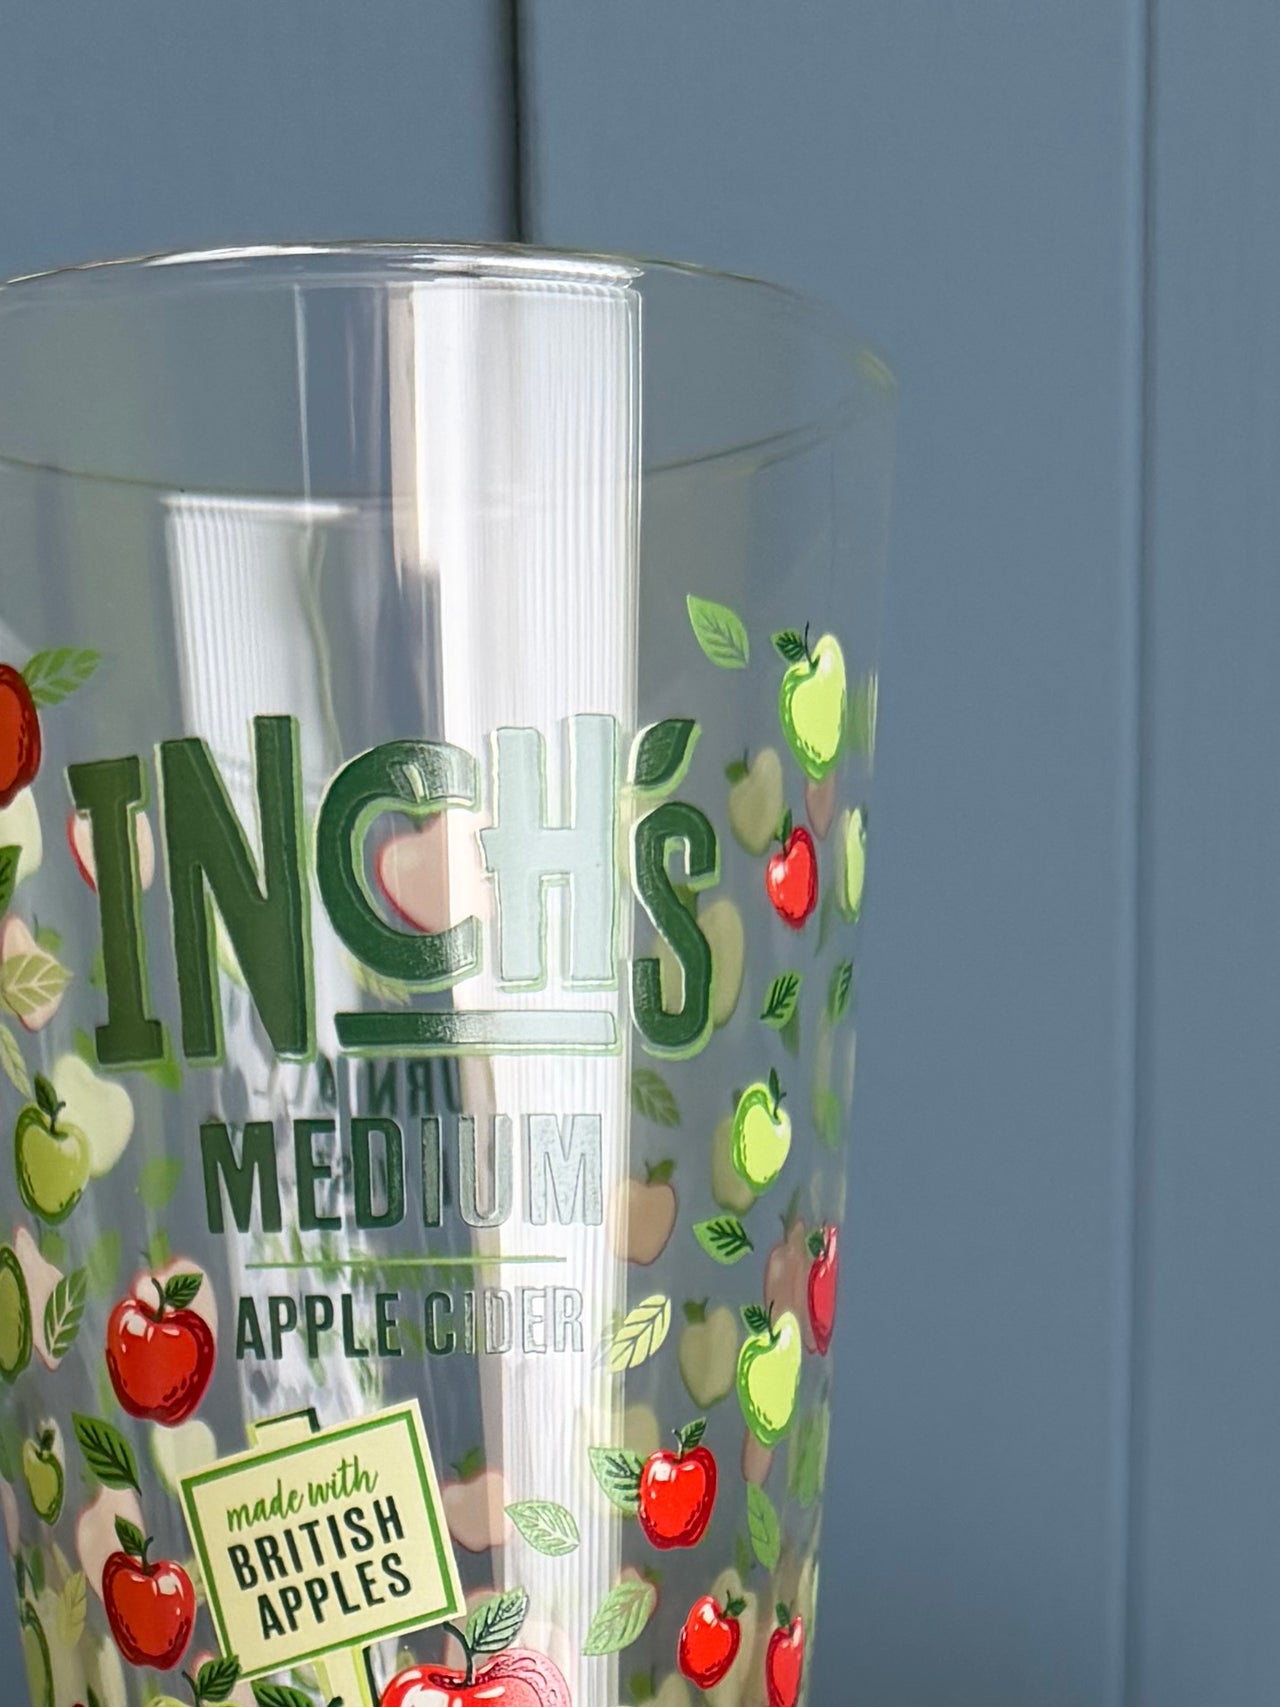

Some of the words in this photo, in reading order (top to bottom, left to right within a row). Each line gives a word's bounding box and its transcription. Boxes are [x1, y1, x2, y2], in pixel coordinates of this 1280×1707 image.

[200, 1113, 604, 1234] MEDIUM
[235, 1288, 402, 1361] APPLE
[425, 1286, 585, 1358] CIDER
[226, 1478, 304, 1533] made
[307, 1454, 379, 1506] with
[227, 1495, 405, 1592] BRITISH
[257, 1552, 412, 1641] APPLES
